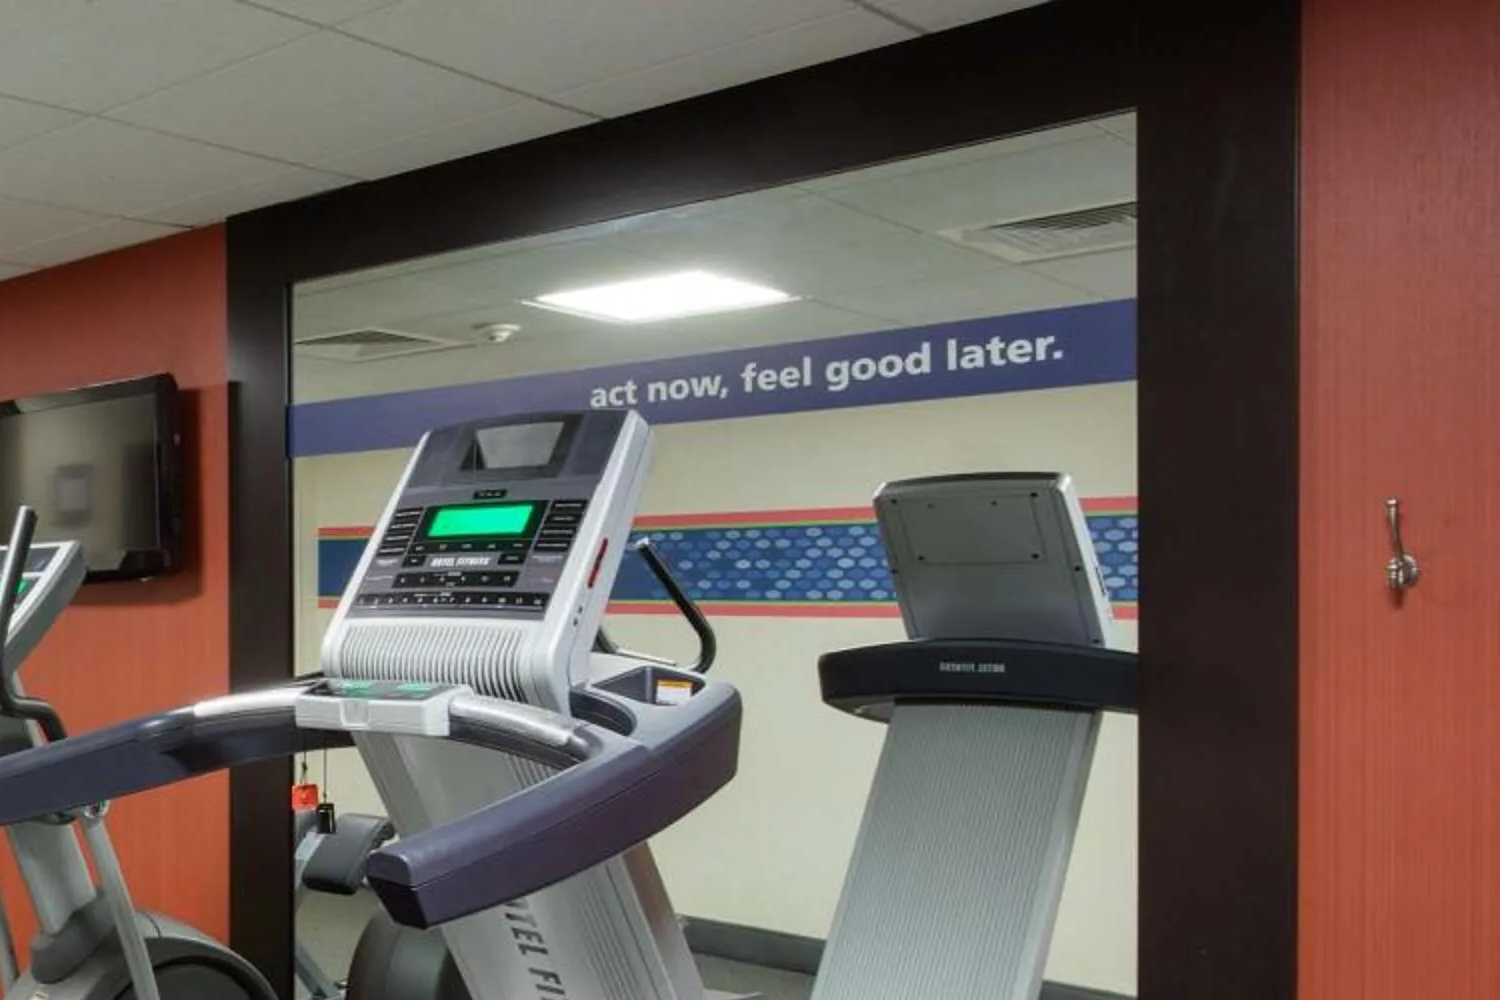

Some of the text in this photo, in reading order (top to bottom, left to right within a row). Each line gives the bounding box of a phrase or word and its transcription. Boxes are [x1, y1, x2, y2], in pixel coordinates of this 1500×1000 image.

[589, 335, 1064, 408] act now, feel good later.
[503, 900, 550, 956] TEL
